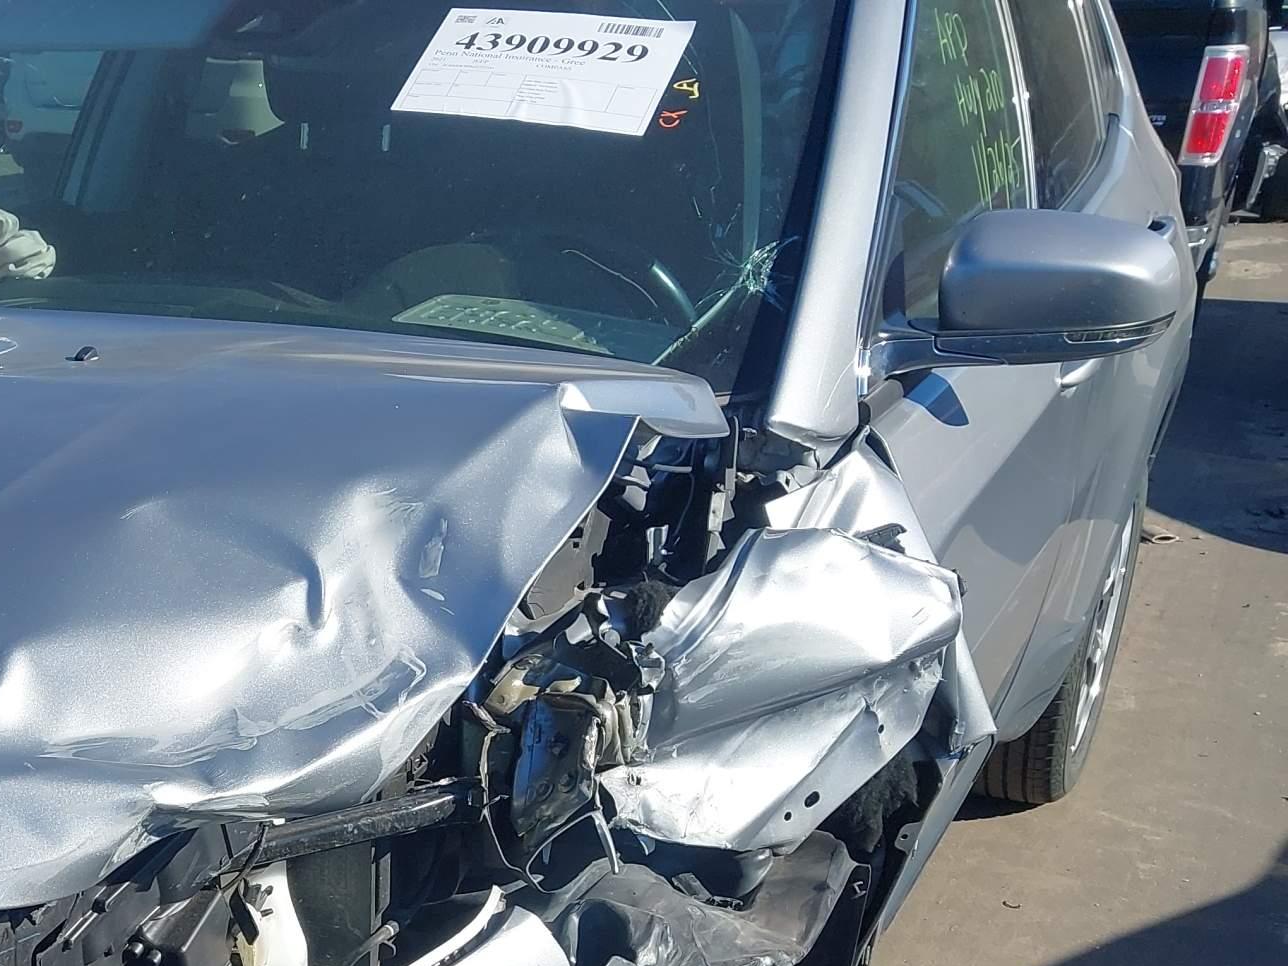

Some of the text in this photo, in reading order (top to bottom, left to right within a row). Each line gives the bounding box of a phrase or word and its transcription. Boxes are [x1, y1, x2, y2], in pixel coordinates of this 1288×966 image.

[434, 49, 459, 57] Penn
[460, 51, 503, 60] National
[503, 53, 552, 63] Insurance
[560, 58, 587, 67] Gree
[455, 31, 650, 64] 43909929
